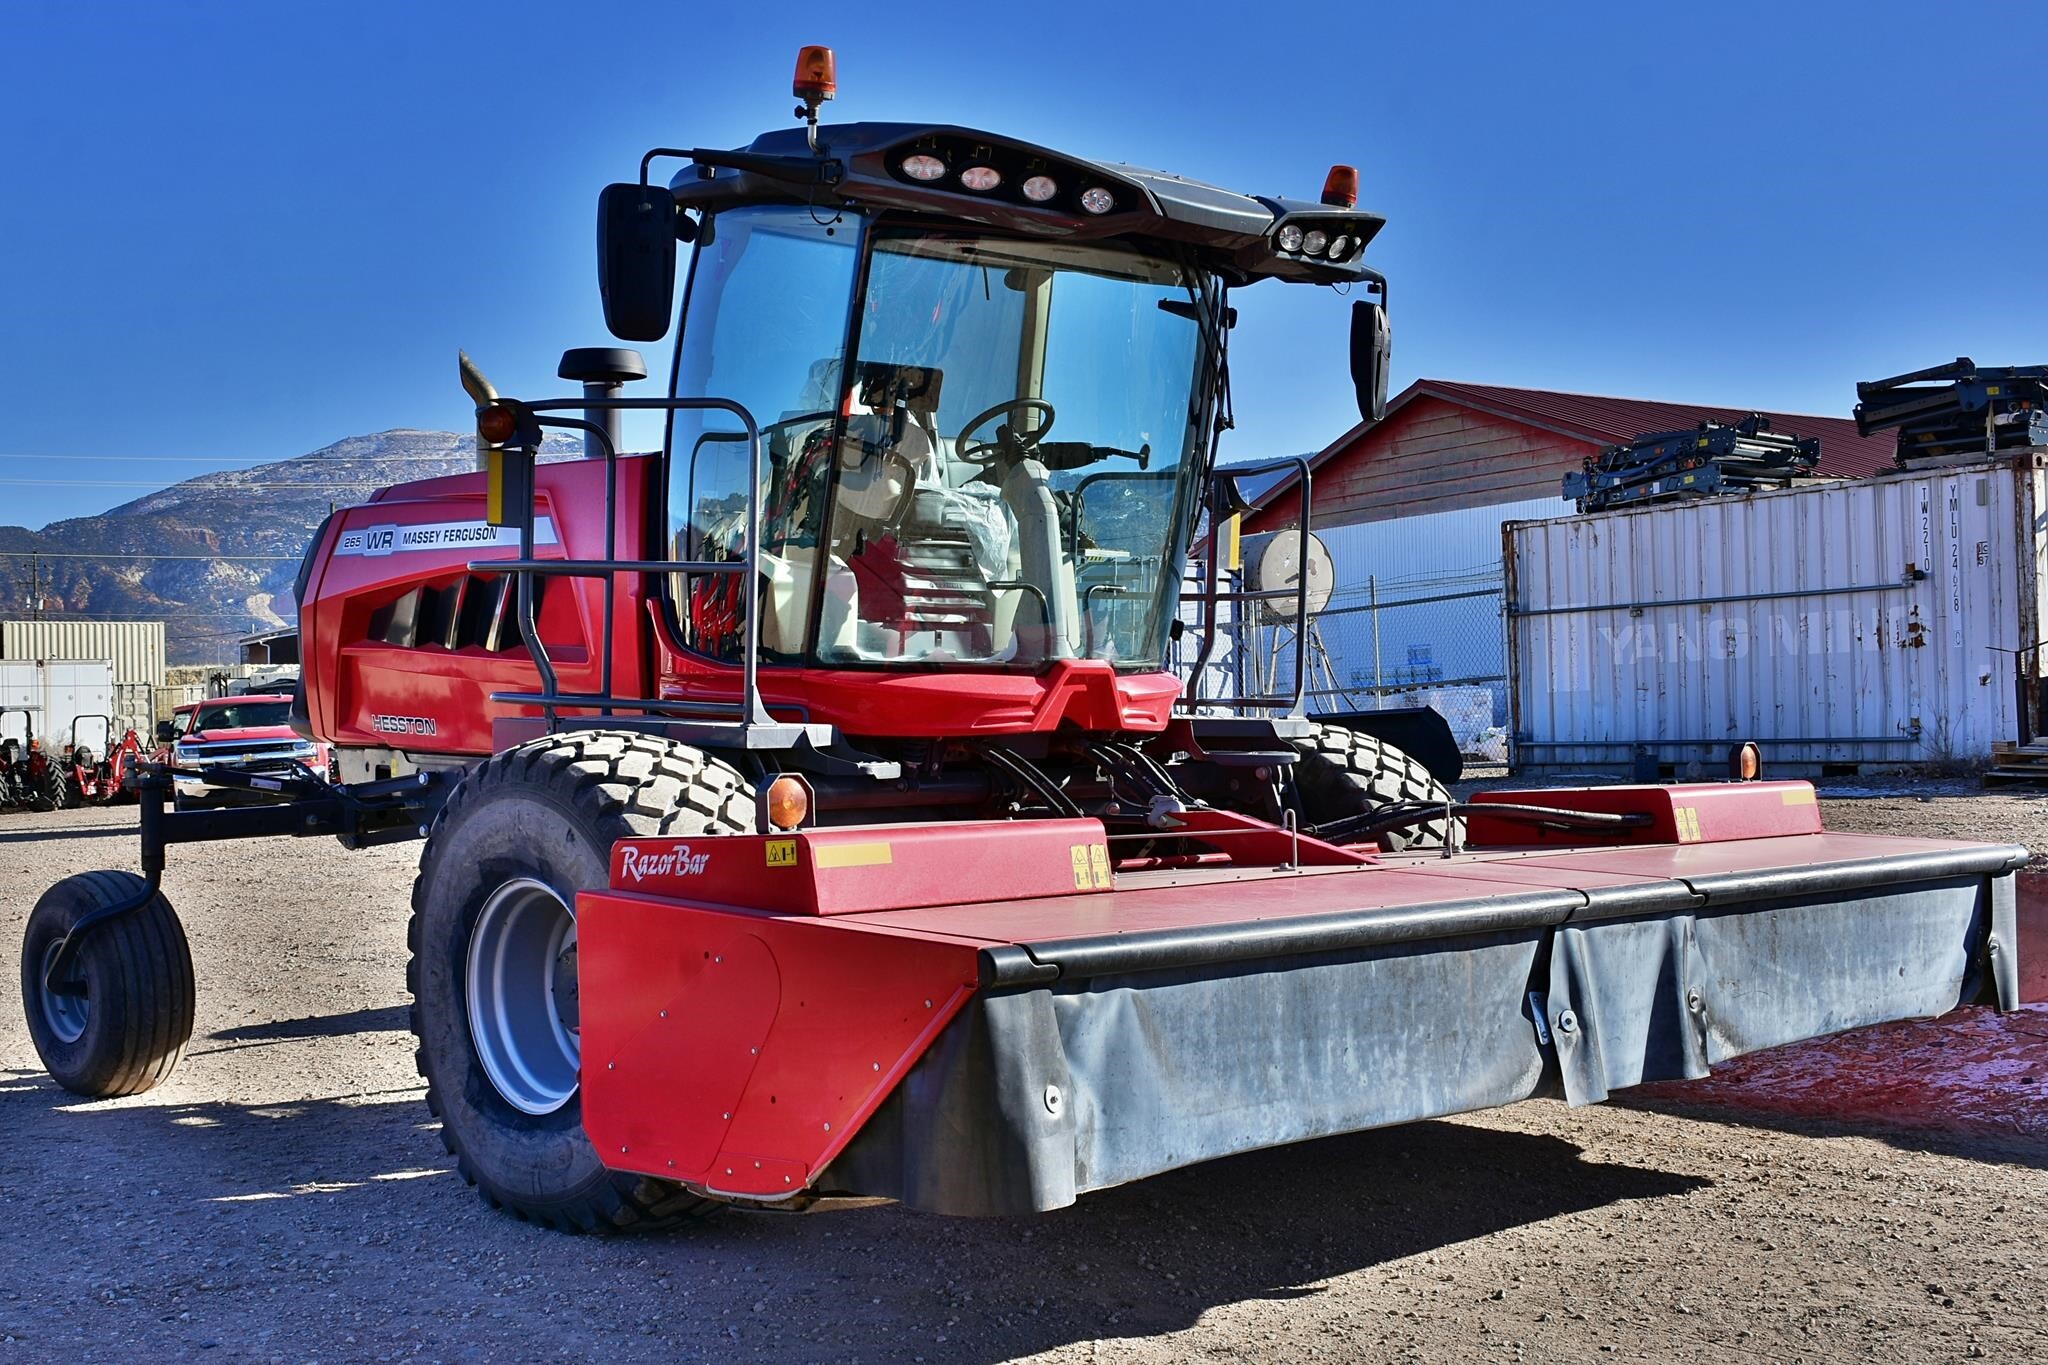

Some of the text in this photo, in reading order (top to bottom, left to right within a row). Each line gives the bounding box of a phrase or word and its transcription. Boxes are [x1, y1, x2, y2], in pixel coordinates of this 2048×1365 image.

[1949, 484, 1958, 539] YMLU
[344, 526, 498, 550] 265 WR MASSEY FERGUSON
[1597, 604, 1933, 665] YANG MING
[372, 714, 437, 736] HESSTON
